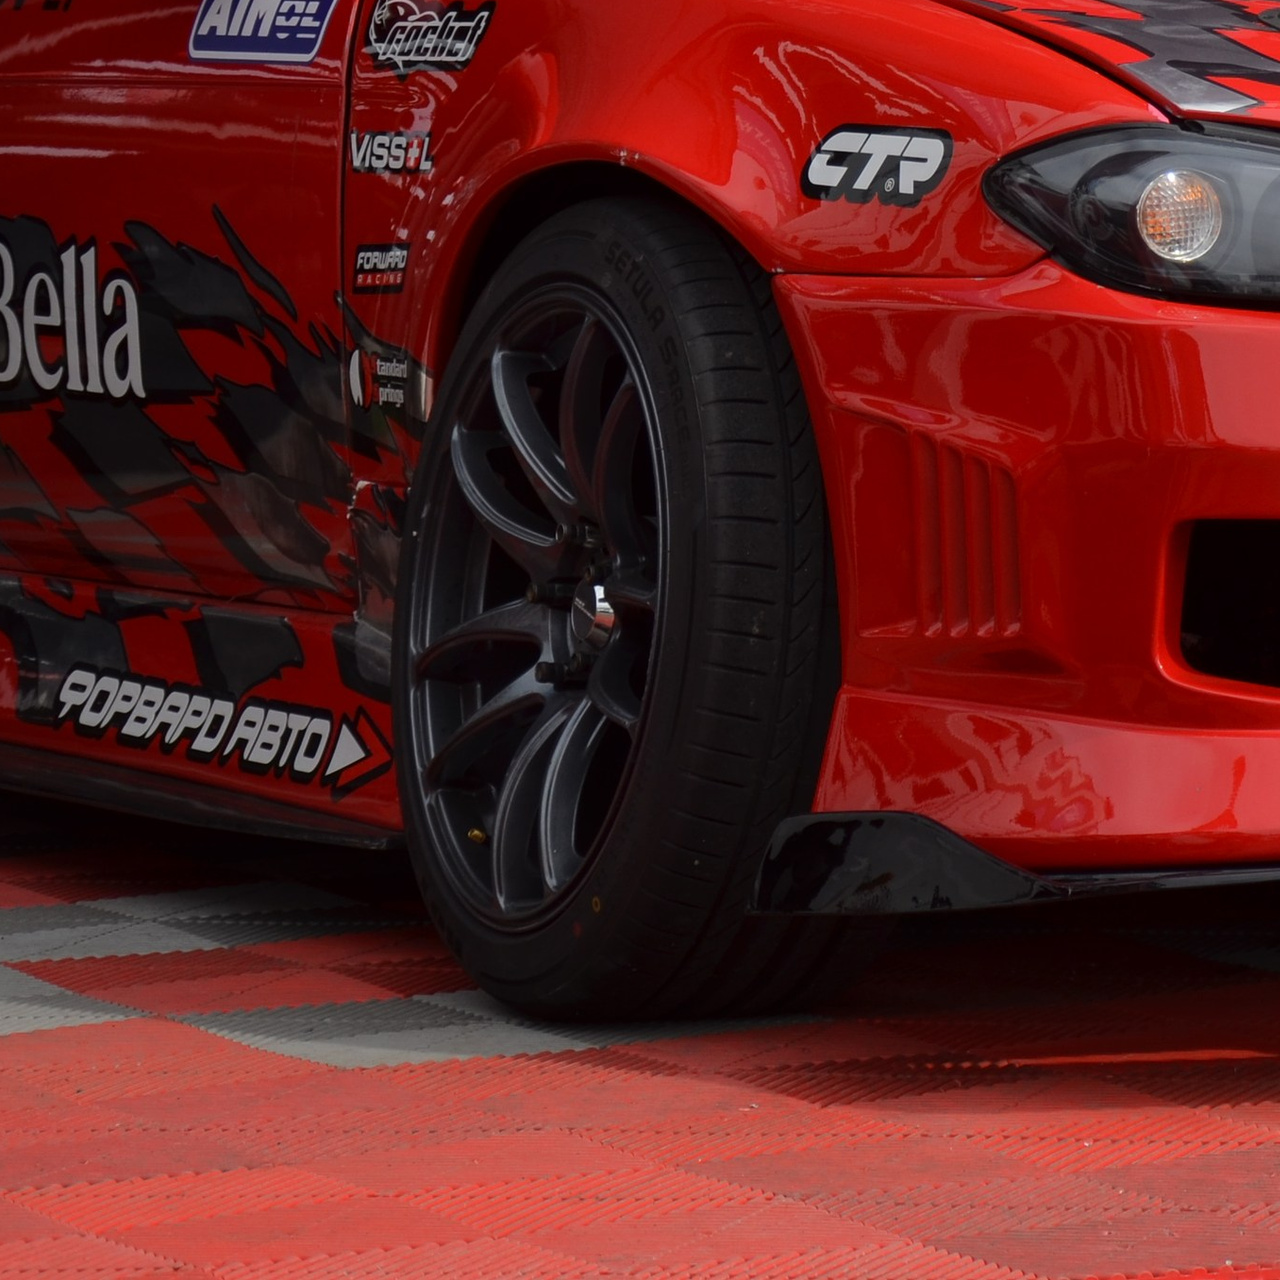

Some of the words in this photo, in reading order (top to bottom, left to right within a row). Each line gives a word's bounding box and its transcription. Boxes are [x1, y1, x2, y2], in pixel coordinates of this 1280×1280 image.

[807, 131, 945, 195] CTP
[356, 250, 408, 270] FORWARD
[356, 273, 403, 285] RACING
